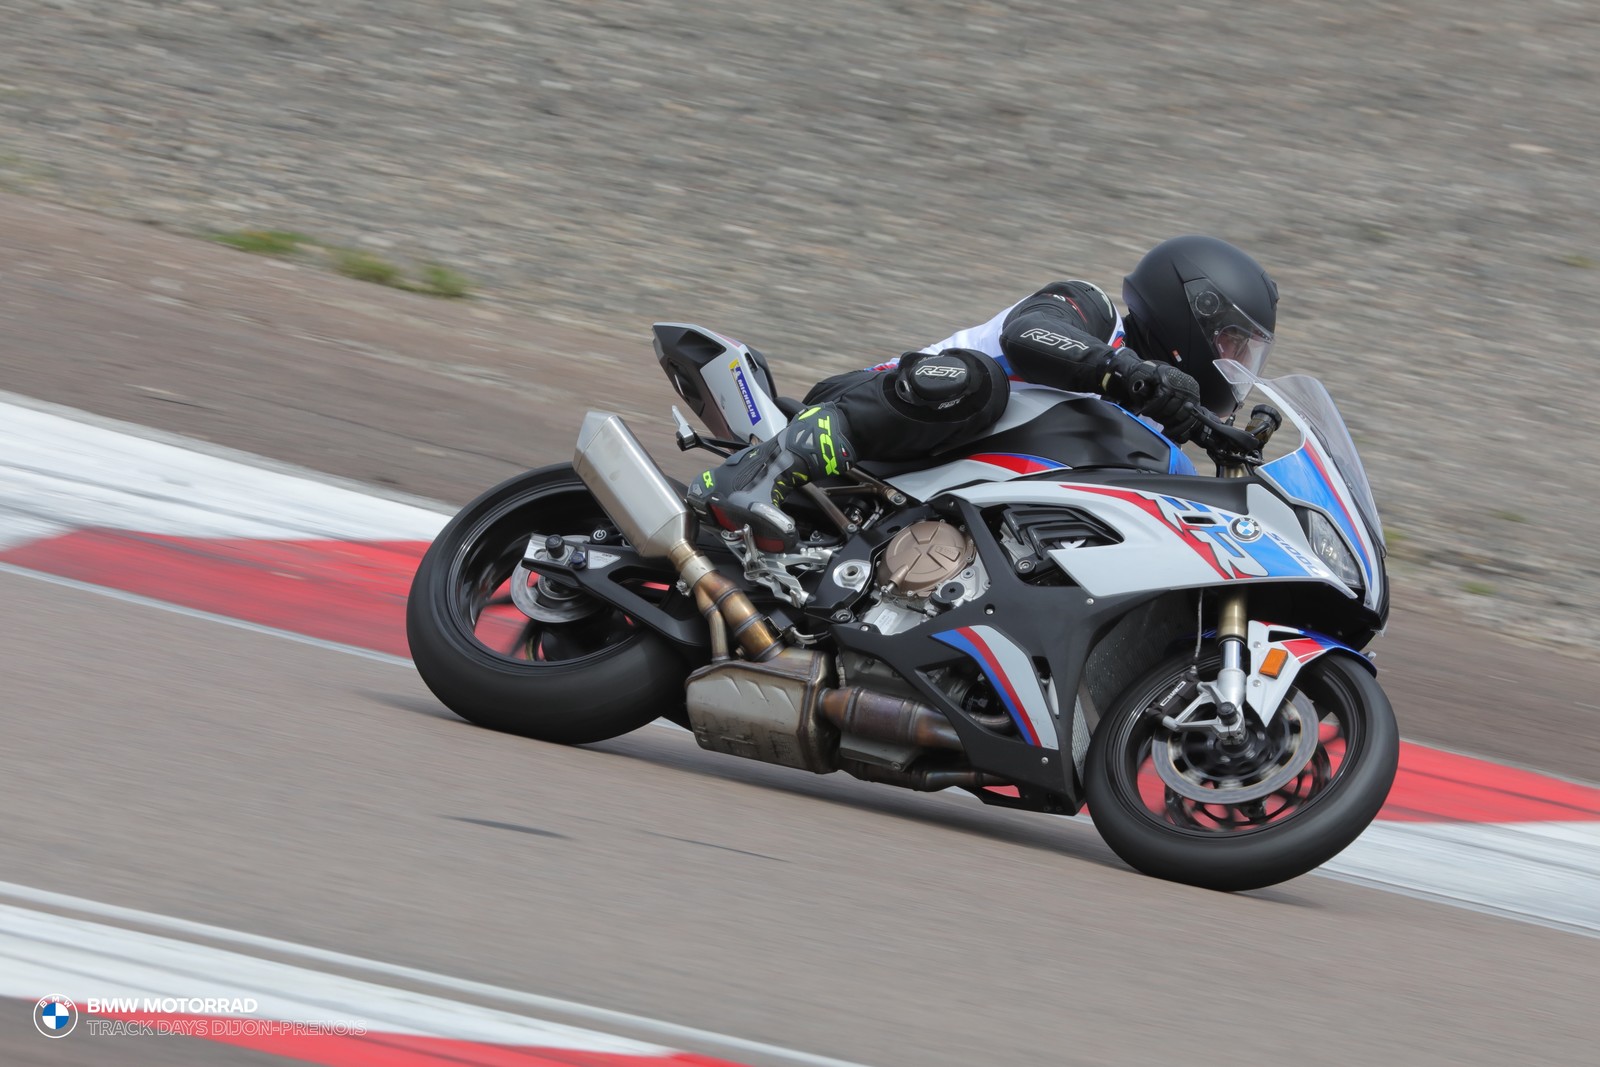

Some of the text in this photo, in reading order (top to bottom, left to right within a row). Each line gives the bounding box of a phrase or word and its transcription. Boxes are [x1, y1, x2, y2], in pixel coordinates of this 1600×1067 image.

[1019, 328, 1089, 350] RST
[915, 365, 966, 378] RST
[738, 379, 757, 418] MICHELIN
[818, 416, 840, 475] TCX
